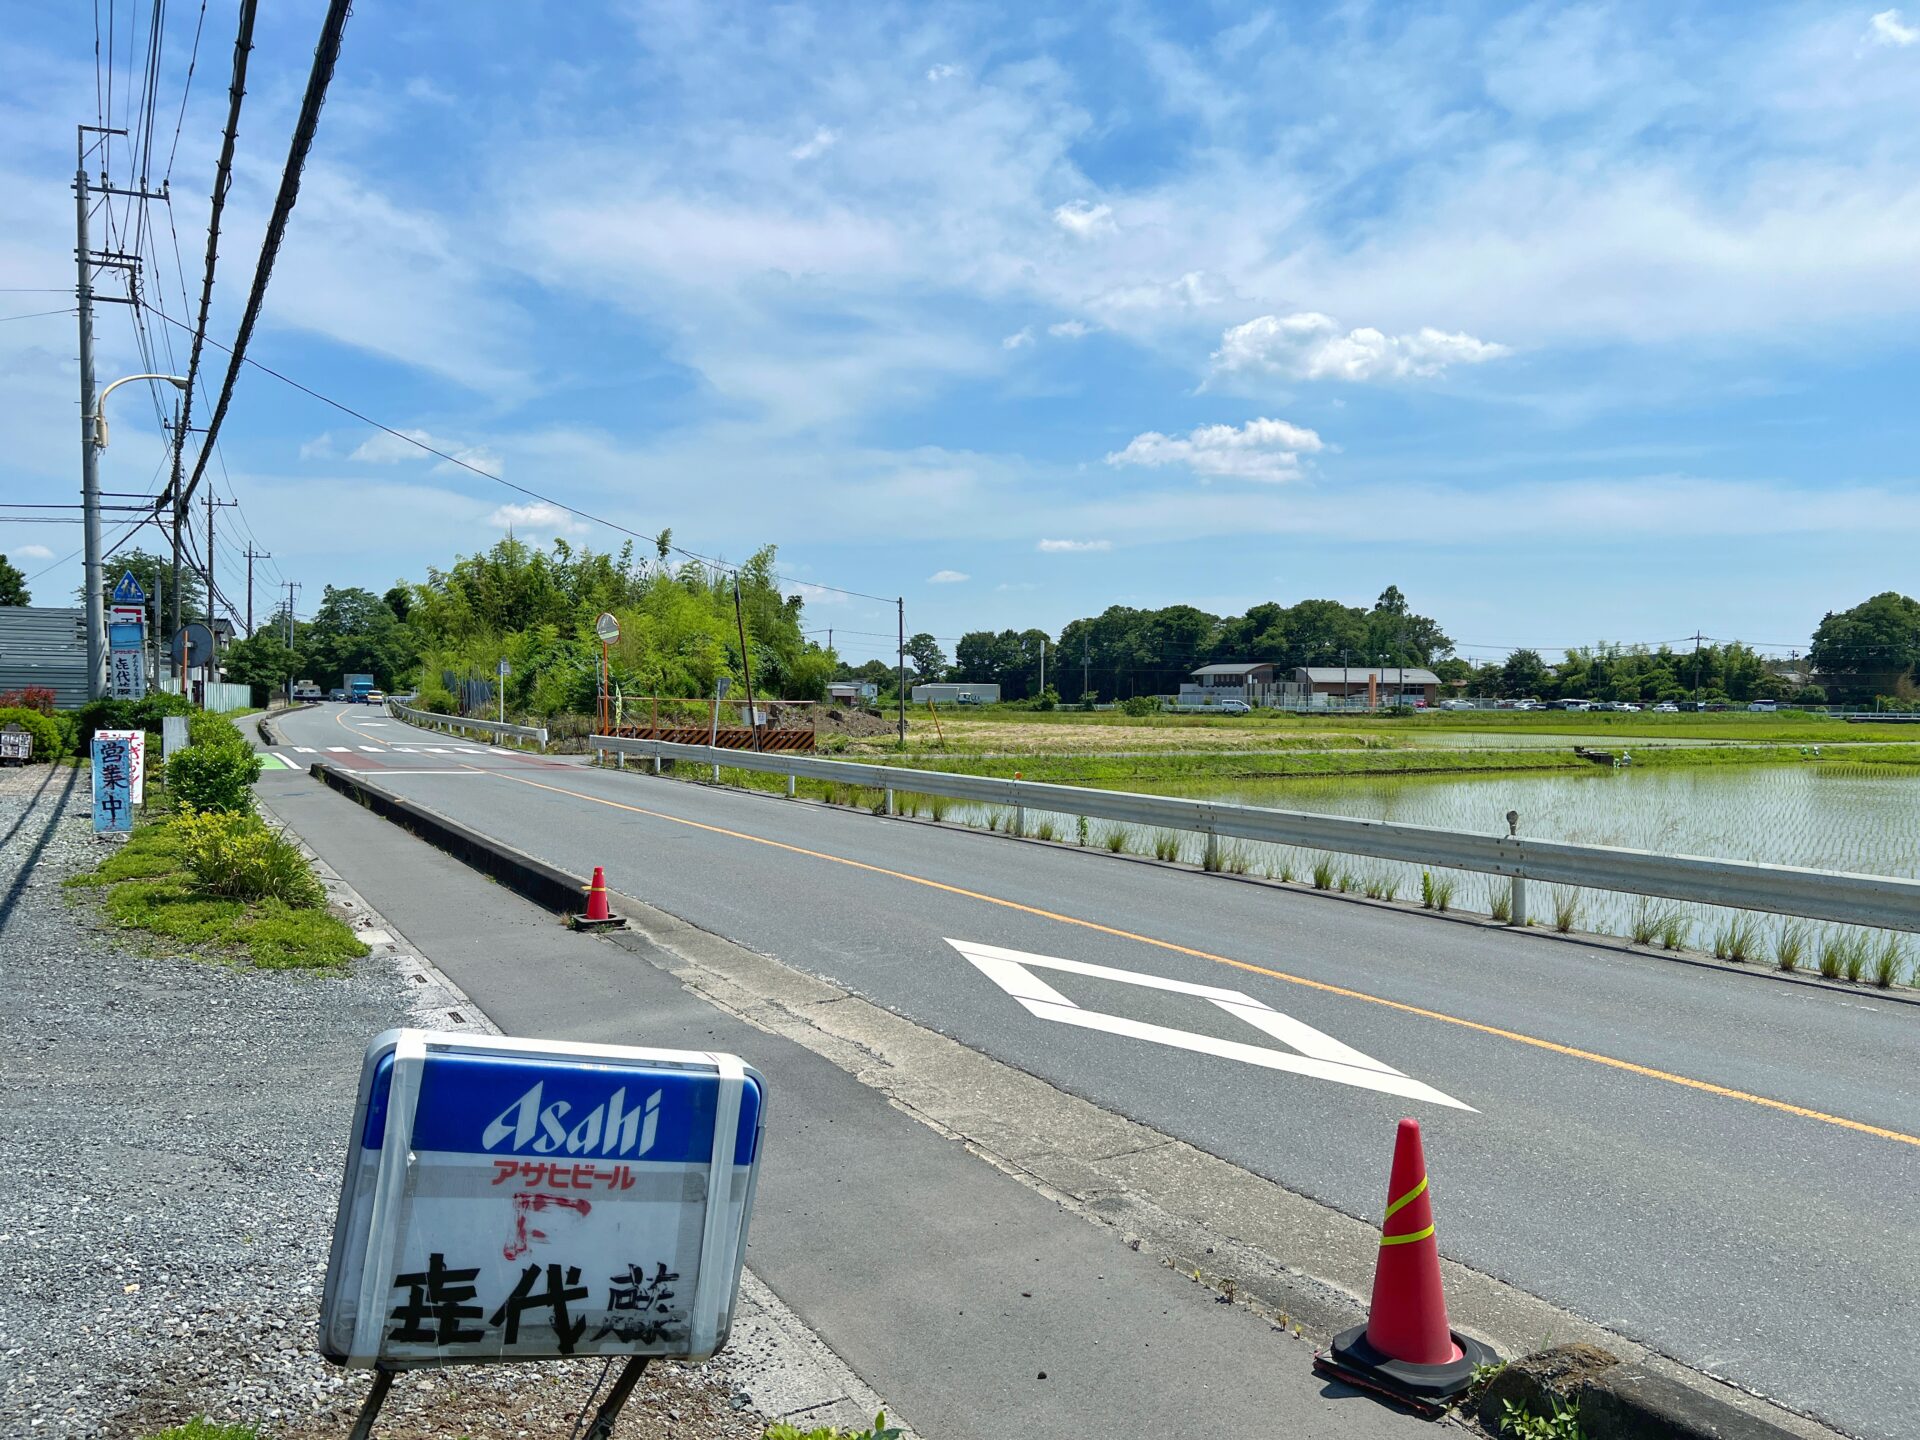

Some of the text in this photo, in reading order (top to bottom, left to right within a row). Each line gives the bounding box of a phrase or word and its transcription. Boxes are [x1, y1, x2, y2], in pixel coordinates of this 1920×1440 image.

[100, 742, 128, 825] 営業中
[482, 1080, 662, 1157] Asahi
[491, 1160, 637, 1191] アサヒビール
